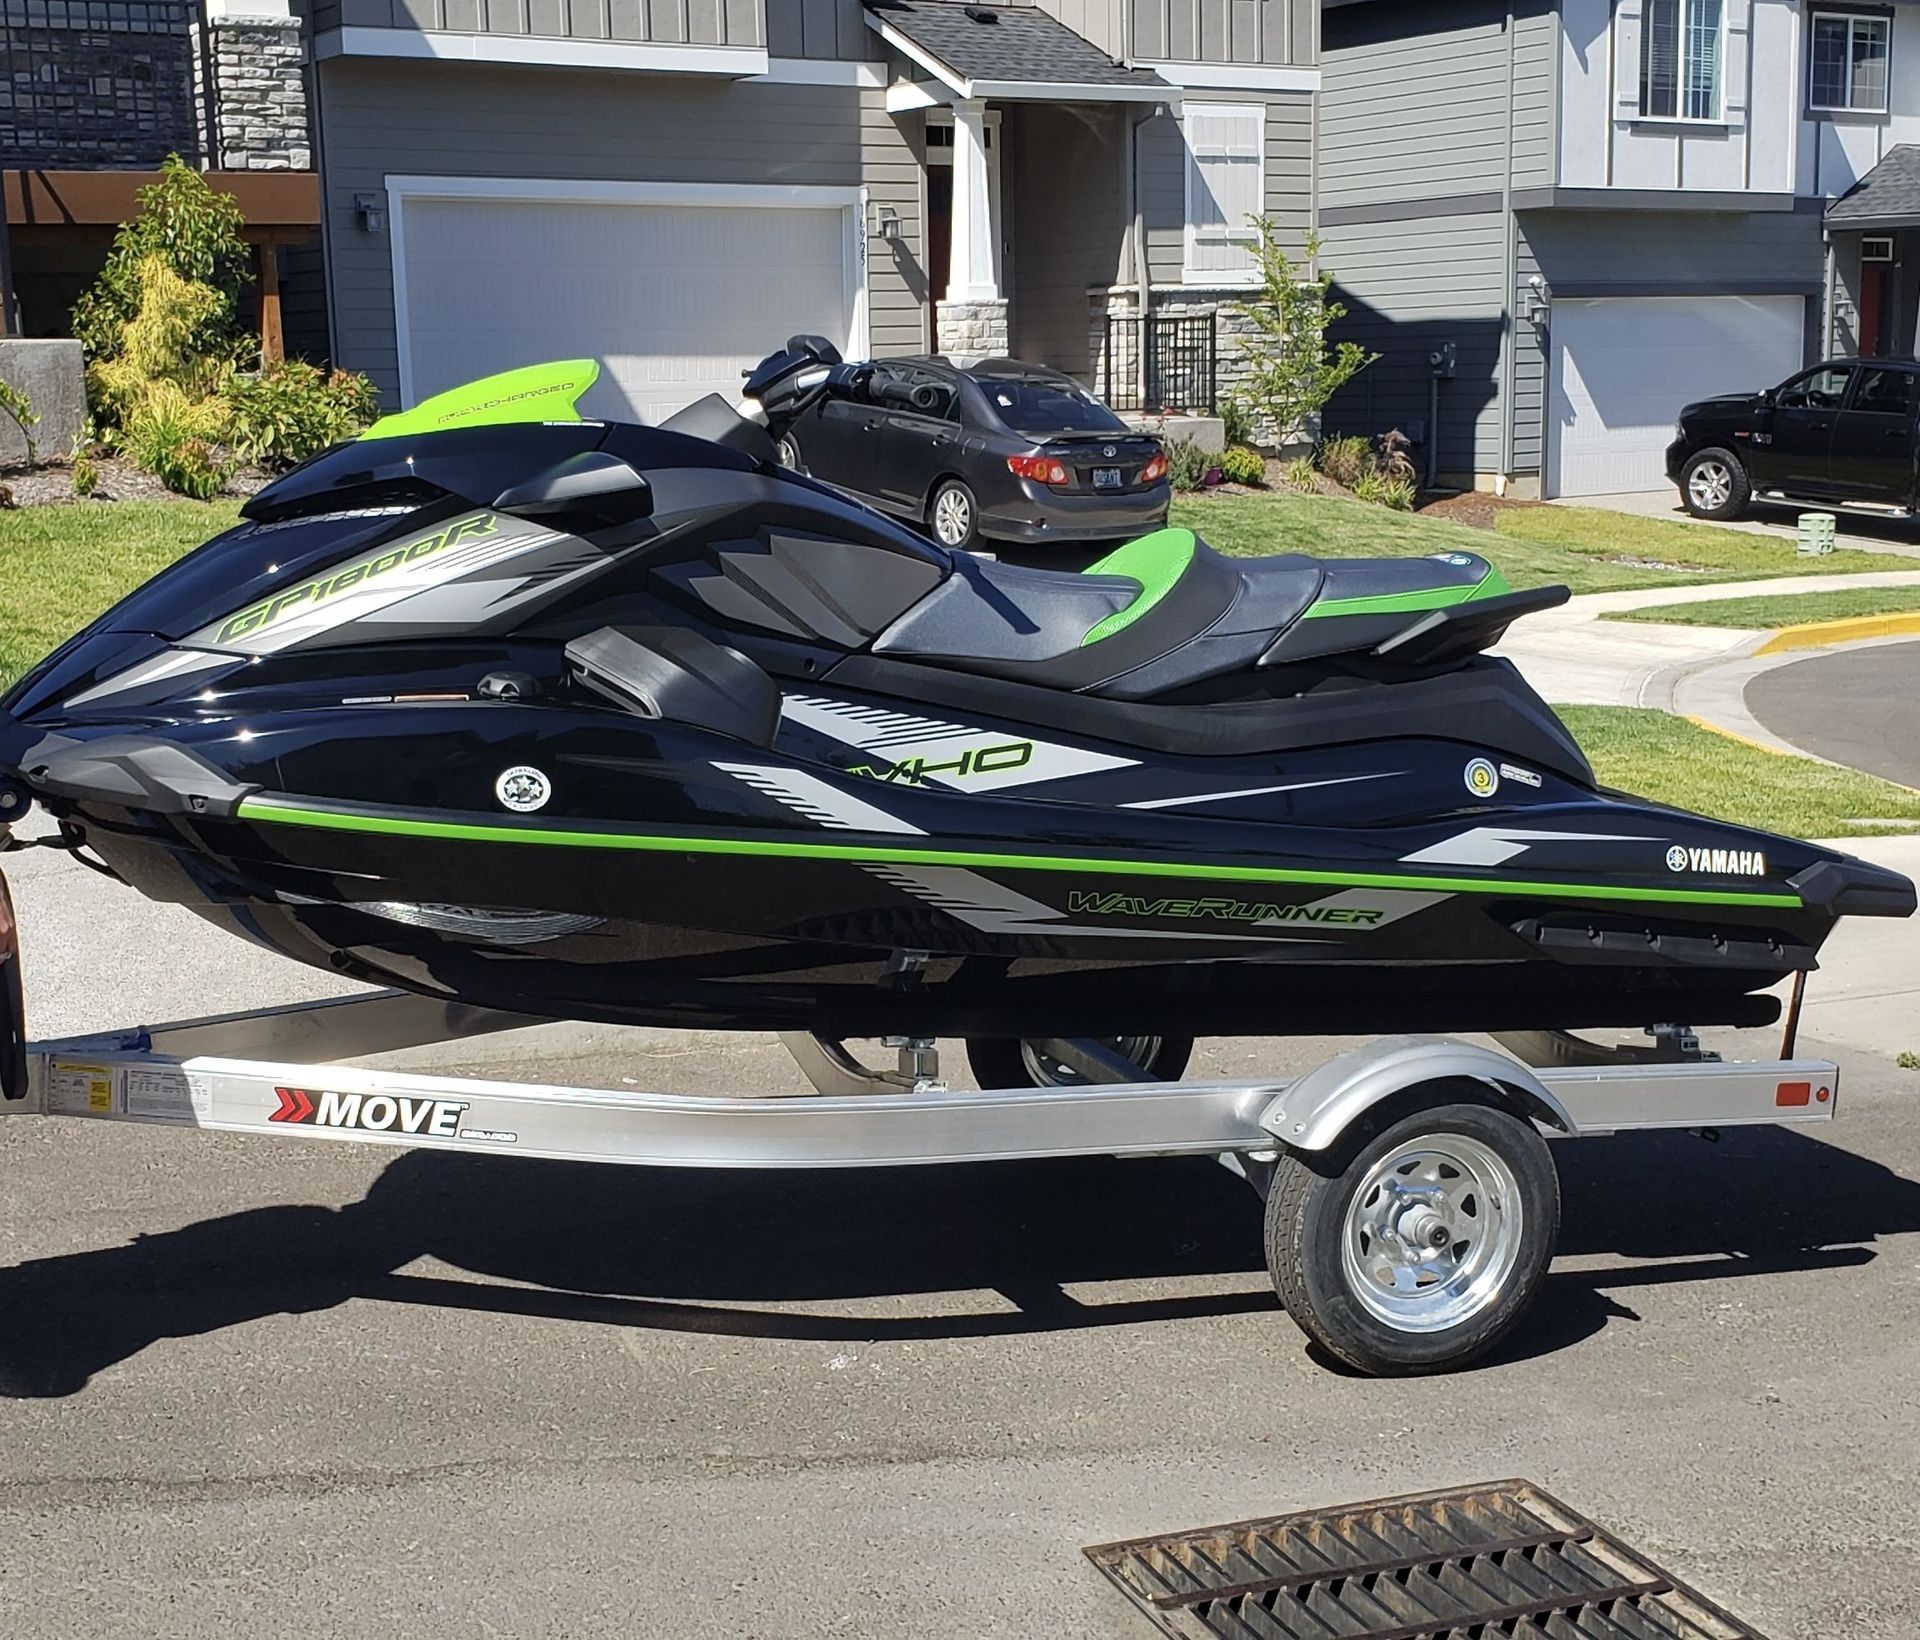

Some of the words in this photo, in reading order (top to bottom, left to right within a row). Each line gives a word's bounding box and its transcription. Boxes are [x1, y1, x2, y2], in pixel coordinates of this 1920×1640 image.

[212, 513, 499, 643] GP1800R
[1477, 772, 1485, 784] 3
[1688, 847, 1765, 876] YAMAHA
[1068, 891, 1384, 925] WAVERUNNER
[315, 1091, 464, 1137] MOVE
